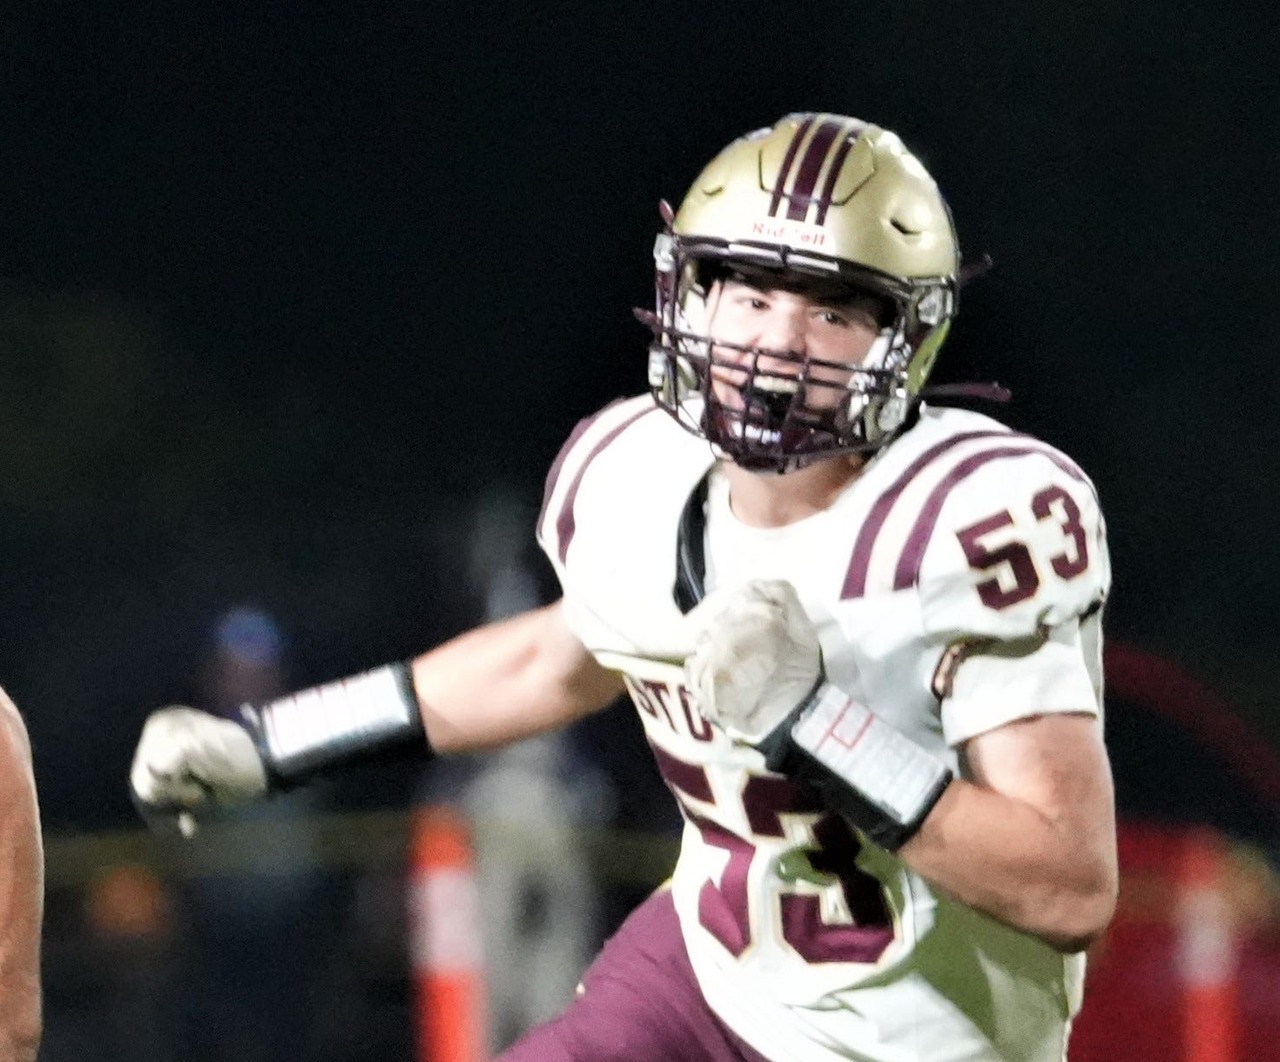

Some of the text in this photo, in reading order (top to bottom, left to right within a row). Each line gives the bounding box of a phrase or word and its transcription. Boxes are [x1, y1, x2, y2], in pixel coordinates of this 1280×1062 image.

[752, 223, 826, 246] Ridell
[954, 484, 1090, 612] 53
[650, 741, 899, 964] 53
